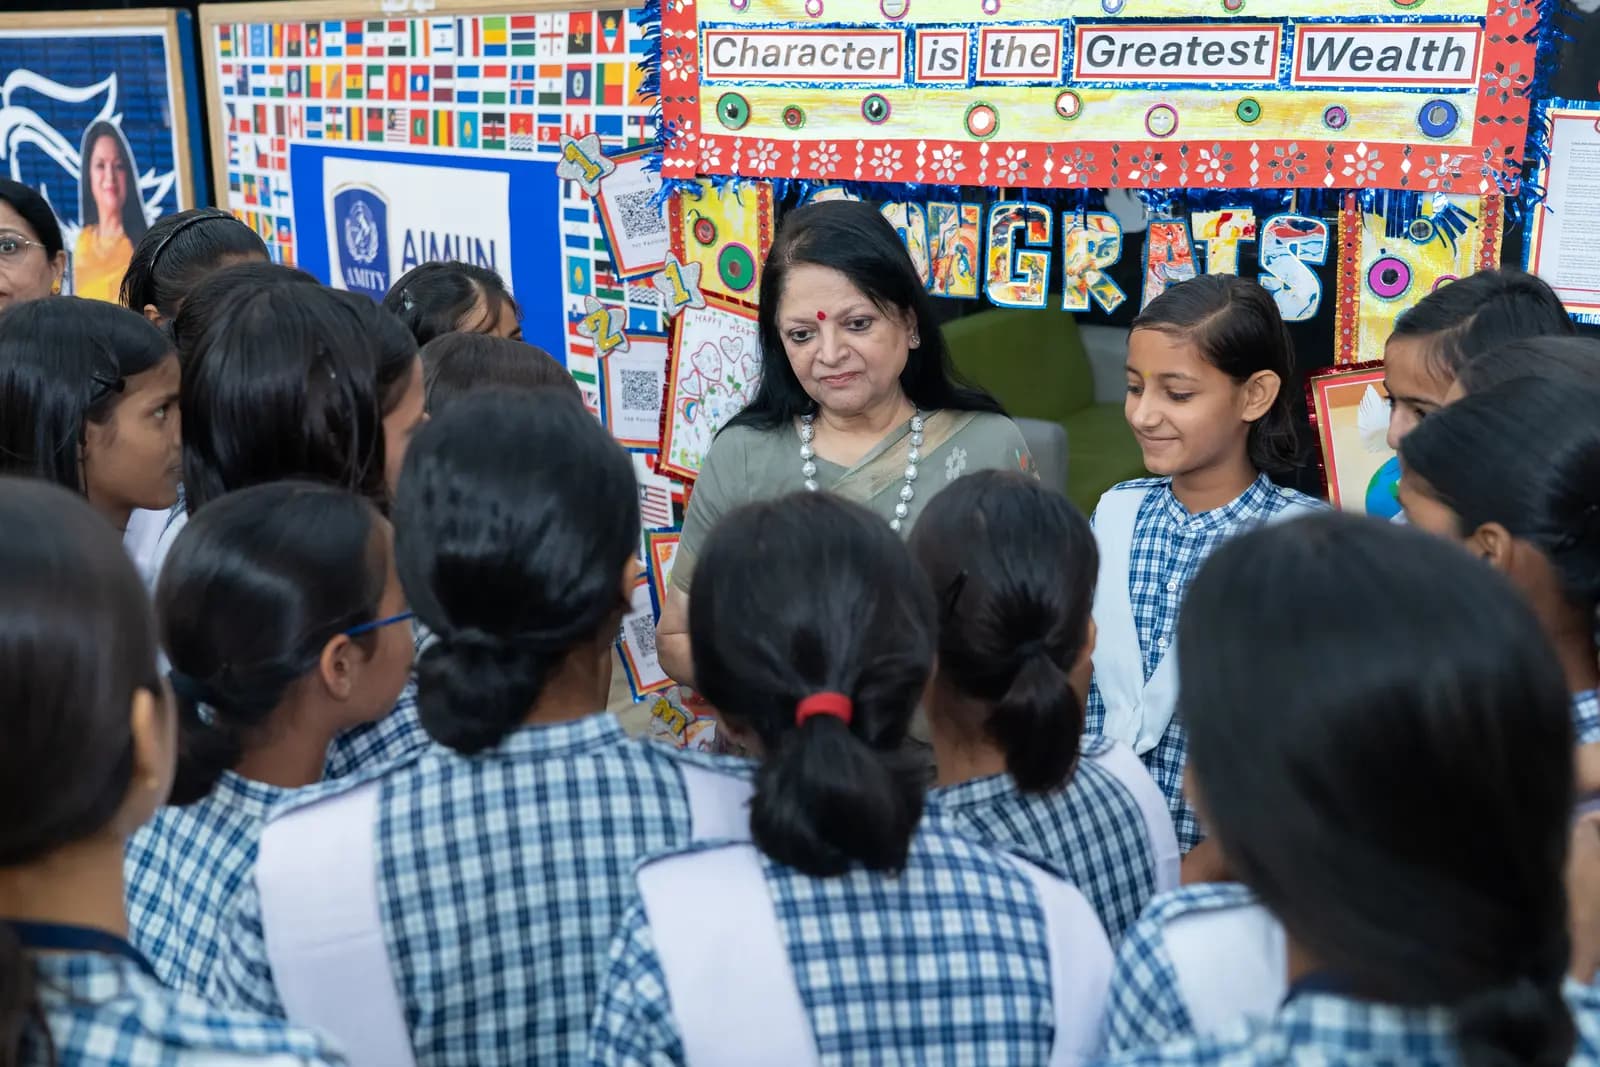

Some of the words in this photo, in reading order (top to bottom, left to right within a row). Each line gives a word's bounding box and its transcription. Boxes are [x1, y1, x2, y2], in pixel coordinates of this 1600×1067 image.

[713, 36, 895, 71] Character
[928, 38, 959, 72] is
[989, 35, 1052, 68] the
[1085, 28, 1270, 68] Greatest
[1305, 27, 1467, 73] Wealth
[808, 185, 1330, 322] ONGRATS
[347, 267, 386, 292] AMITY
